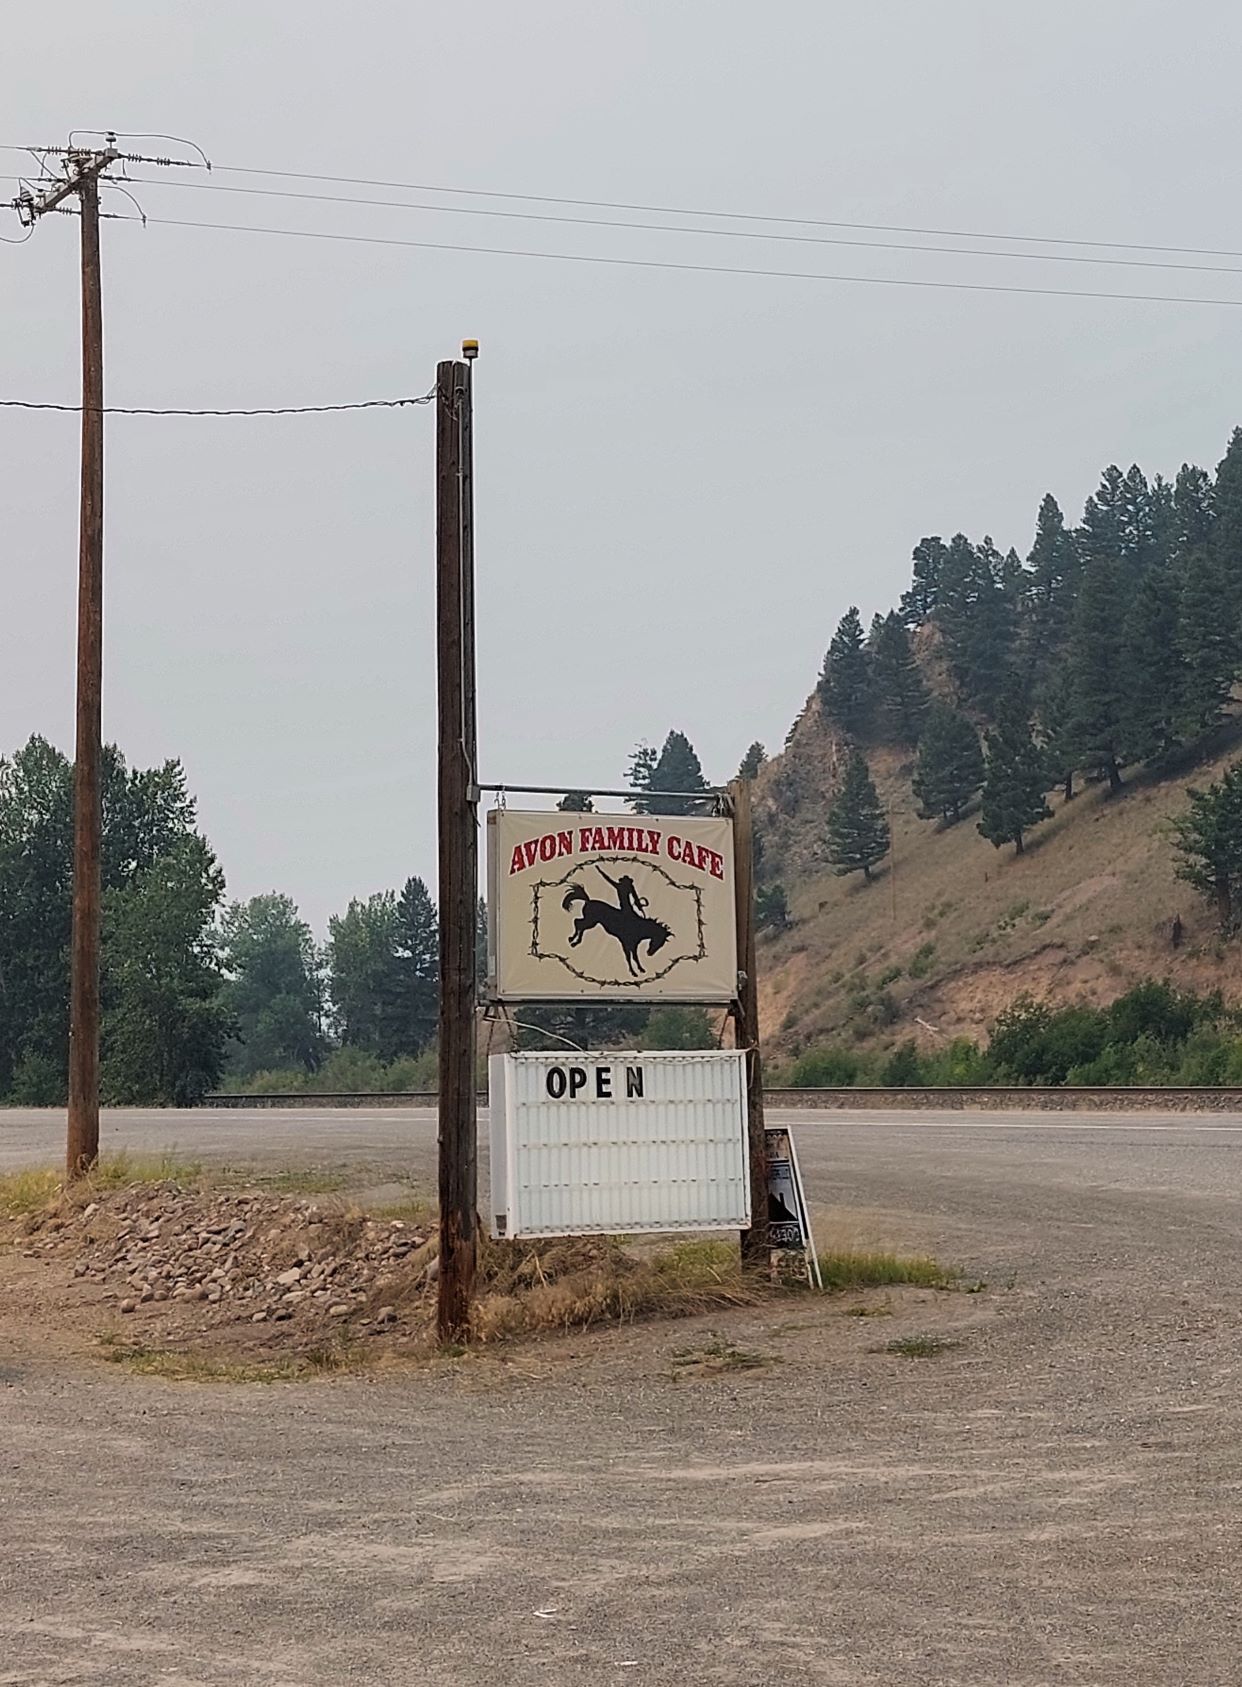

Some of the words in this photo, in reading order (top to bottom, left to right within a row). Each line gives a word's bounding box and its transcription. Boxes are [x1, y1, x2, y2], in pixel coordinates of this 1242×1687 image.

[510, 830, 573, 875] AVON
[578, 826, 661, 855] FAMILY
[667, 836, 724, 880] CAFE
